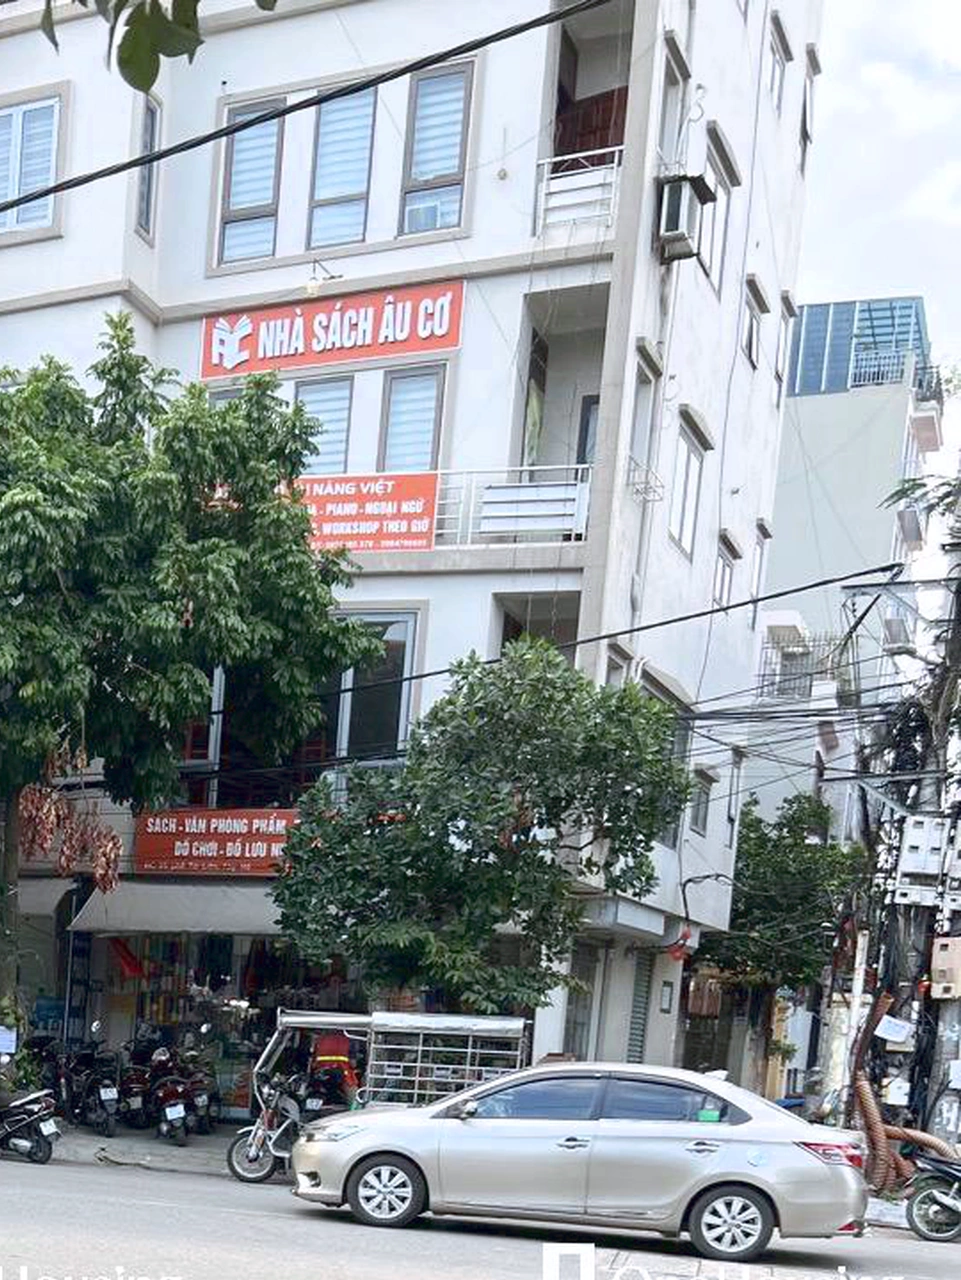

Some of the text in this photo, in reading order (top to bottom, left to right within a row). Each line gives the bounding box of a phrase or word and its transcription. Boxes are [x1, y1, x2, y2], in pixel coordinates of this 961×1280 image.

[258, 292, 453, 359] NHÀ SÁCH ÂU CƠ
